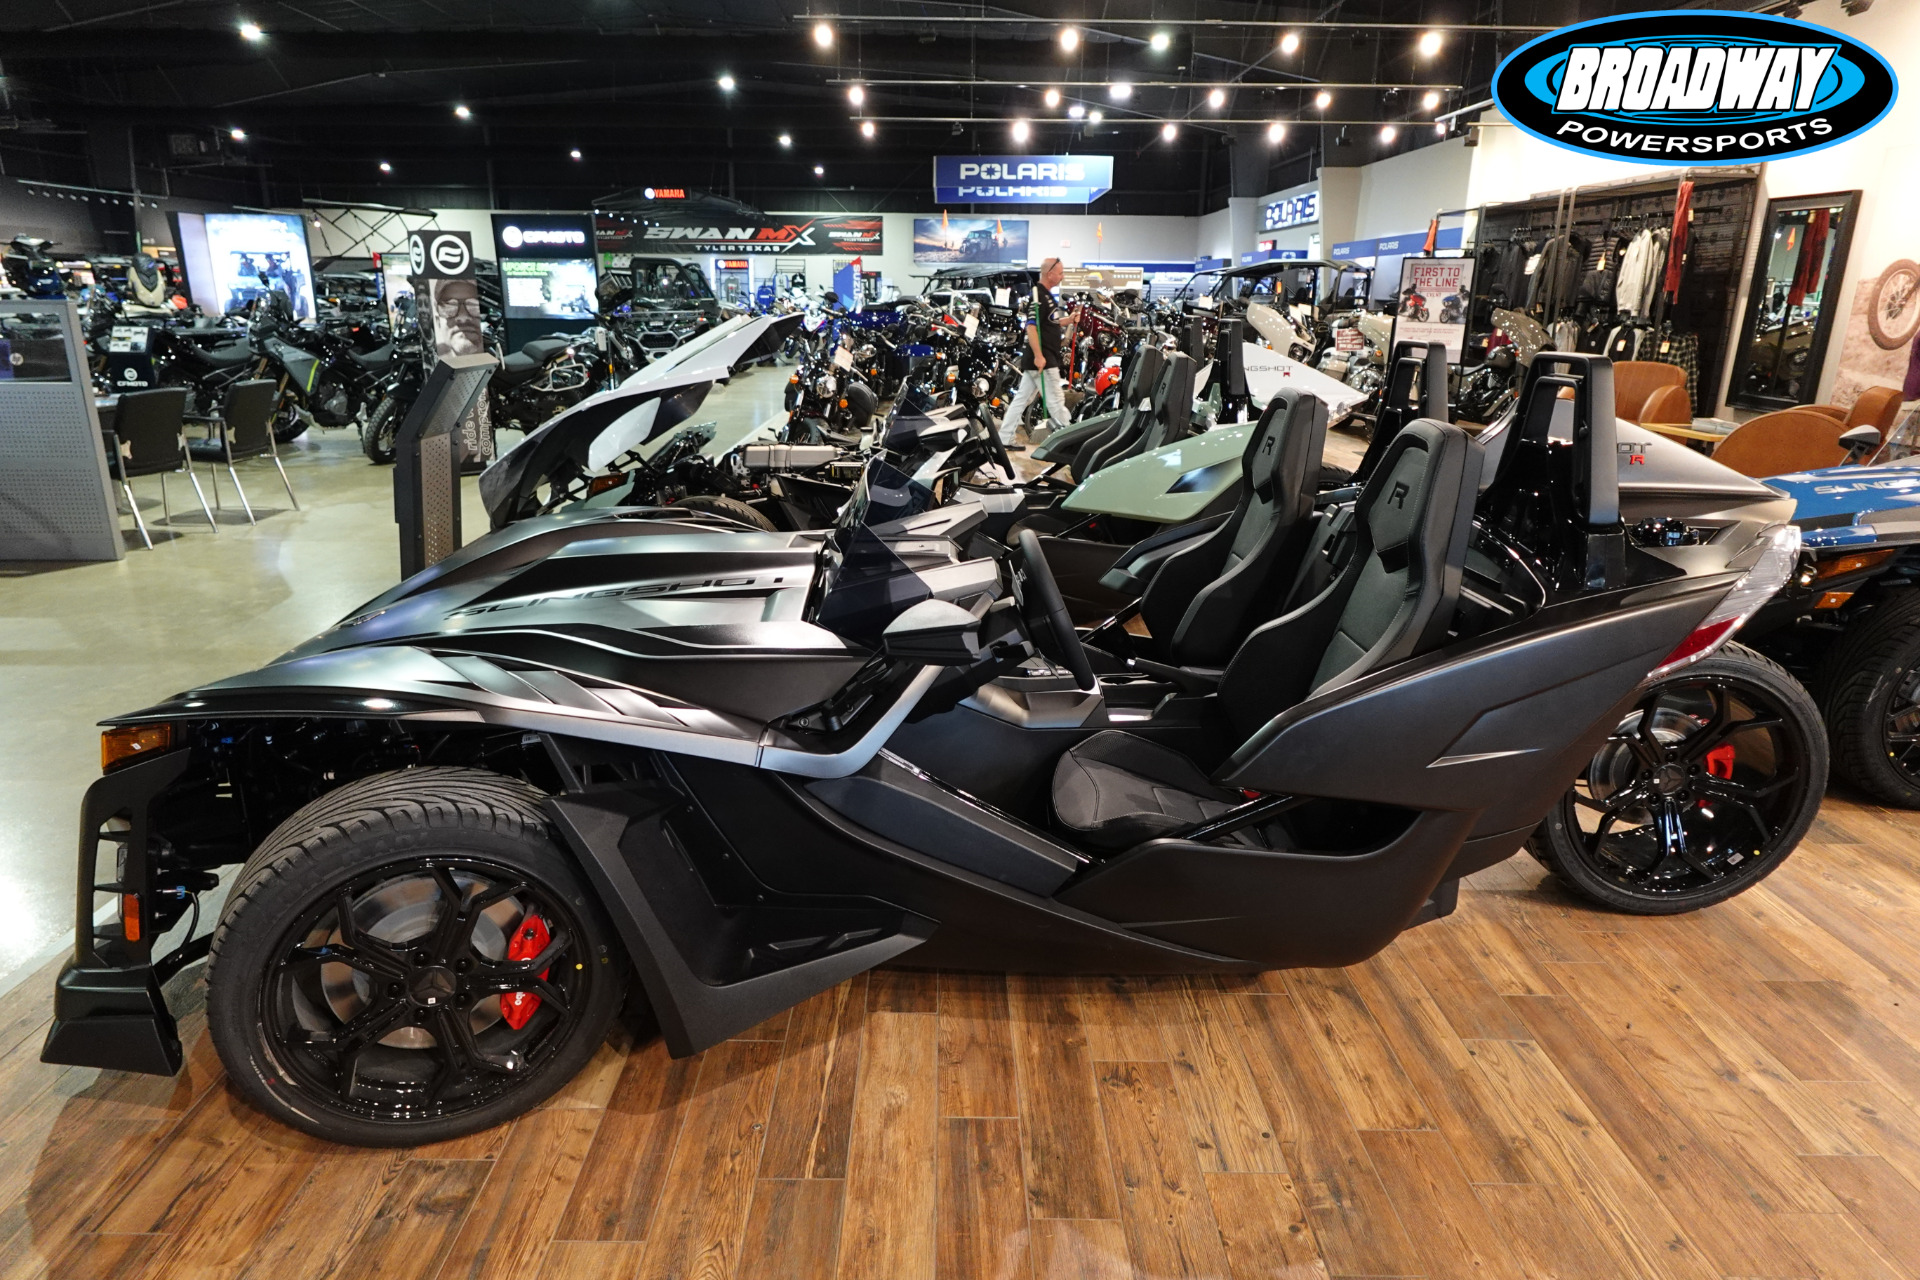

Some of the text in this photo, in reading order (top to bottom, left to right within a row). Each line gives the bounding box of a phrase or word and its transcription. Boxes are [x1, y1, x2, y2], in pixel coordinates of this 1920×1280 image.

[959, 163, 1085, 181] POLARIS
[654, 189, 685, 198] YAMAHA
[1265, 194, 1316, 226] POLARIS
[644, 218, 816, 253] SWAN MX
[1379, 241, 1399, 250] POLARIS
[725, 260, 749, 268] YAMAHA
[1414, 267, 1460, 277] FIRST TO
[853, 264, 862, 300] SUZU
[1413, 278, 1459, 287] THE LINE
[462, 420, 478, 451] ride
[1262, 436, 1276, 455] R
[1630, 455, 1645, 465] R
[1387, 481, 1410, 509] R
